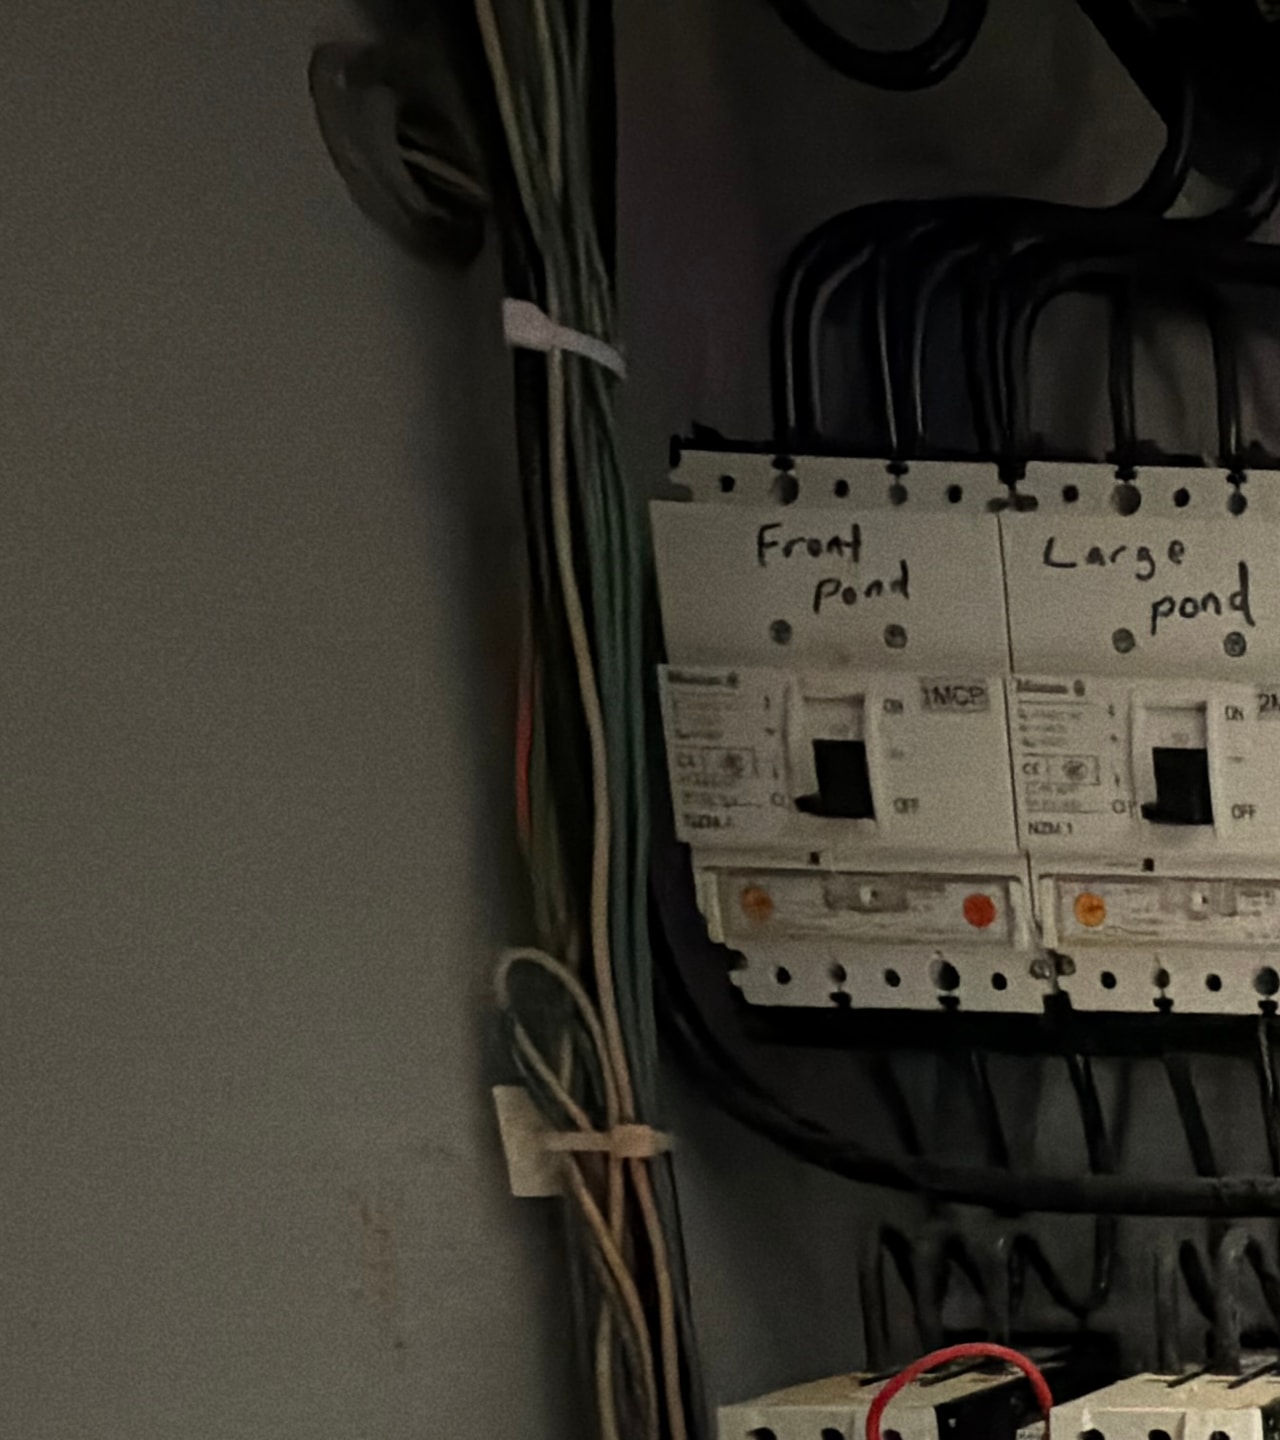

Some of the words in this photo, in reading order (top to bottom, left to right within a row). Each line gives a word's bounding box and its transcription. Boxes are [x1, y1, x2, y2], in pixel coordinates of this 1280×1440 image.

[757, 522, 861, 568] Front
[1043, 536, 1186, 582] Large
[1150, 560, 1257, 636] pond
[921, 685, 986, 707] 1MCP
